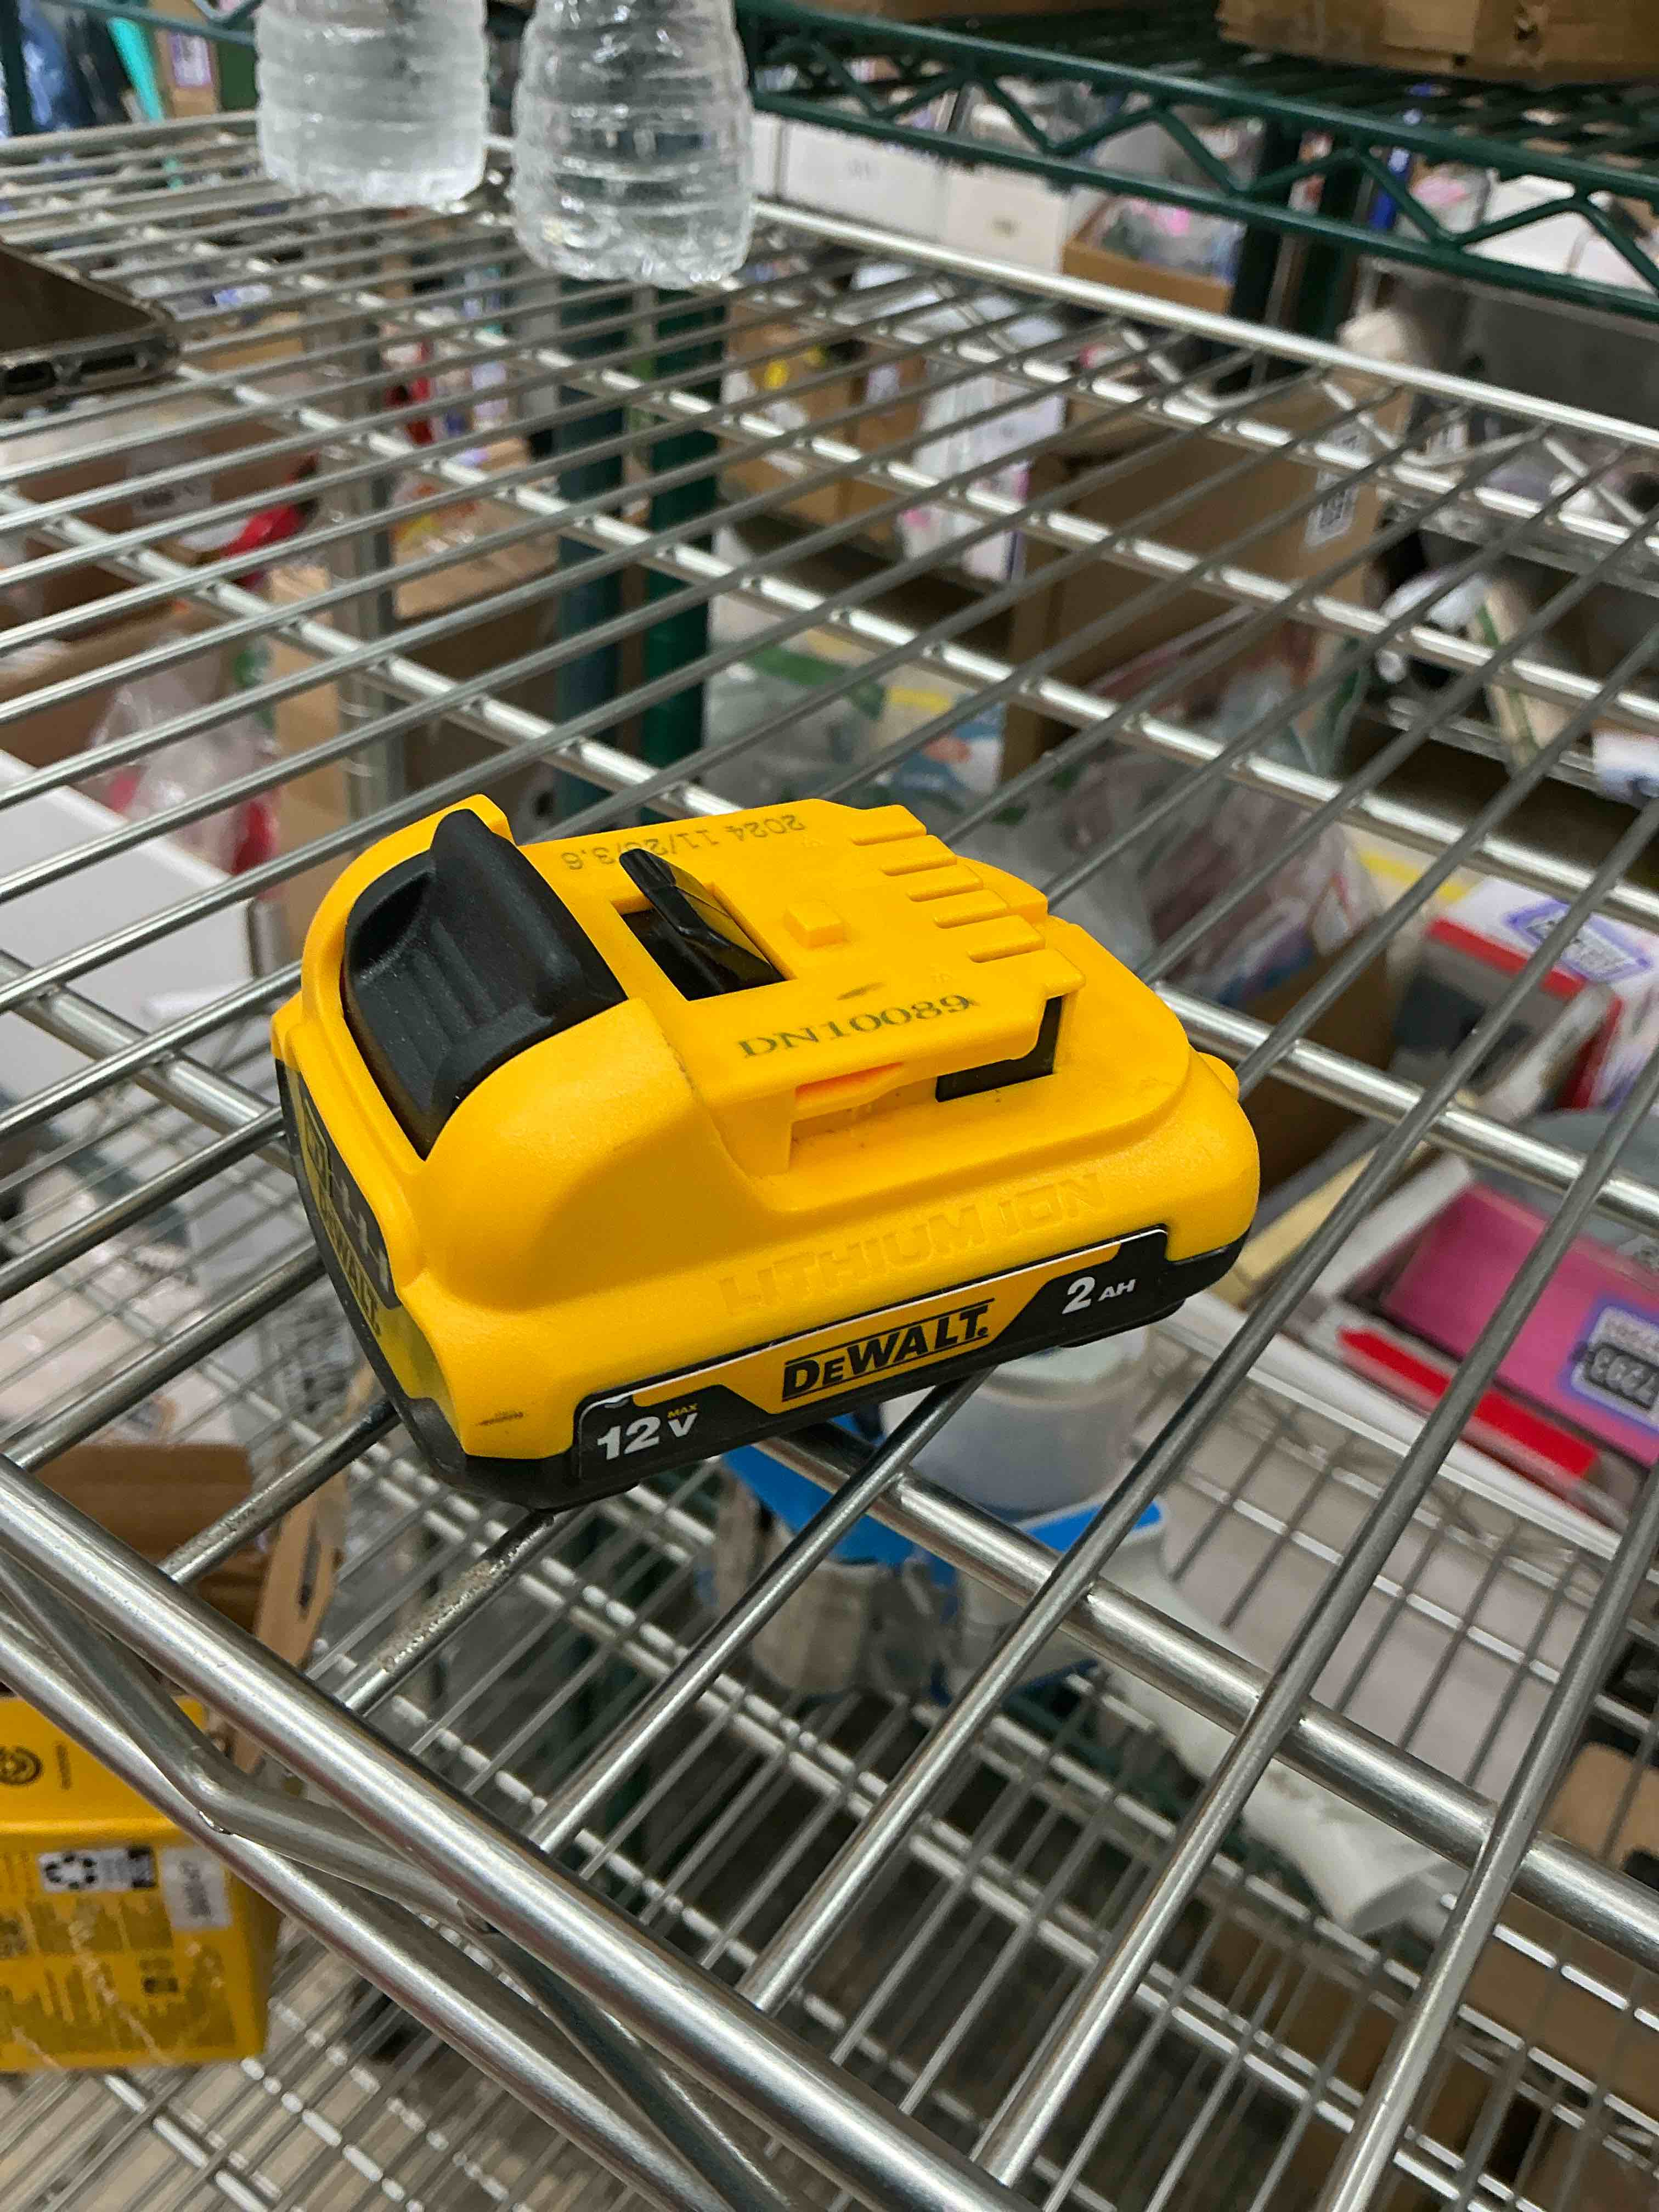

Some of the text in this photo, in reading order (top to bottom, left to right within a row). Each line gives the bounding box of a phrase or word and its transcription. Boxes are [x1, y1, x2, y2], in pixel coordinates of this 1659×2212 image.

[726, 814, 805, 842] 2024
[738, 994, 977, 1058] DN10089
[719, 1170, 1107, 1314] LITHIUM ION
[1062, 1277, 1137, 1314] 2 AH
[667, 1403, 698, 1419] MAX
